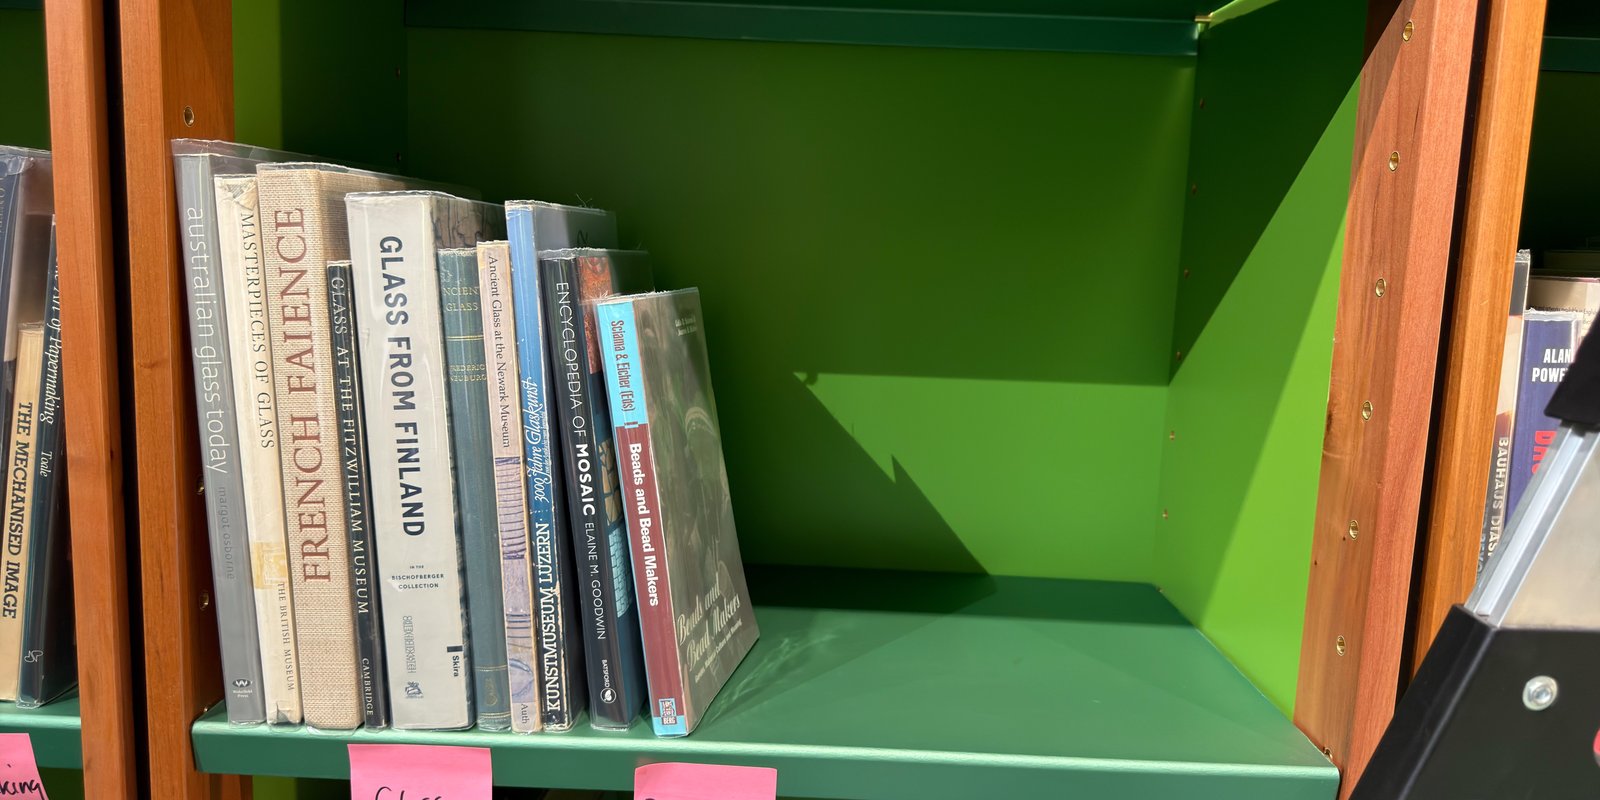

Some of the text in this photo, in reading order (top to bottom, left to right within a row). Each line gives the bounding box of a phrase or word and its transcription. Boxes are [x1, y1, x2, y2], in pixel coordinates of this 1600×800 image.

[187, 206, 230, 474] australian glass today
[240, 213, 275, 449] MASTERPIECES OF GLASS
[446, 303, 479, 312] GLASS
[611, 320, 626, 352] Sciama
[40, 335, 63, 425] Papermaking
[379, 235, 425, 536] GLASS FROM FINLAND
[488, 256, 510, 448] Ancient Glass at the Newark Museum
[616, 362, 632, 388] Eicher
[1531, 367, 1567, 382] POWE
[1543, 348, 1574, 363] ALAN
[274, 207, 331, 583] FRENCH FAIENCE
[521, 376, 543, 445] Glaskunst
[556, 282, 596, 516] ENCYCLOPEDIA OF MOSAIC
[619, 390, 636, 412] (Eds)
[331, 276, 369, 614] GLASS AT THE FITZWILLIAM MUSEUM
[526, 446, 552, 485] Jahre
[1492, 436, 1509, 510] BAUHAUS
[2, 402, 32, 619] THE MECHANISED IMAGE
[534, 477, 550, 504] 3000
[628, 443, 660, 607] Beads and Bead Makers
[217, 486, 235, 580] margot osborne
[536, 522, 553, 584] LUZERN
[585, 522, 607, 640] ELAINE M. GOODWIN
[277, 583, 295, 691] THE BRITISH MUSEUM
[452, 655, 460, 678] Skira
[540, 587, 561, 712] KUNSTMUSEUM
[602, 659, 610, 688] BATSFORD
[362, 657, 374, 717] CAMBRIDGE
[520, 703, 530, 724] Auth
